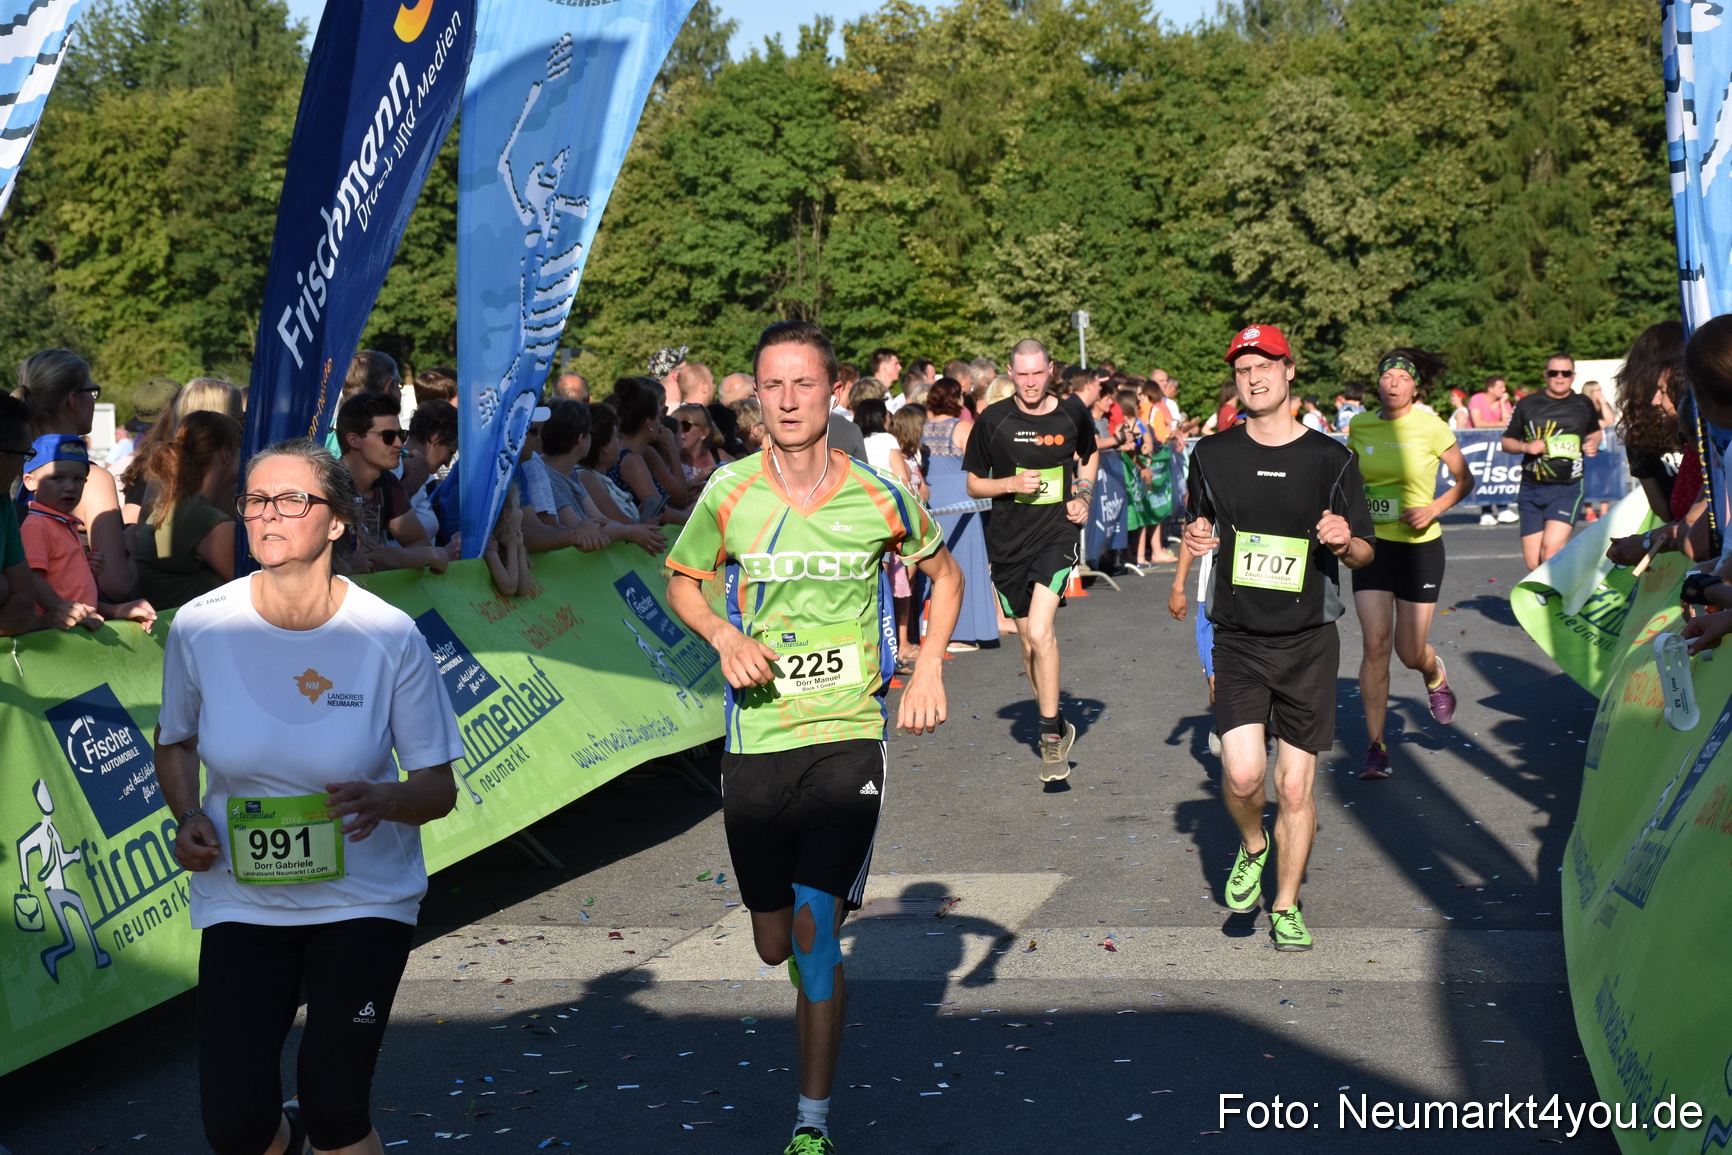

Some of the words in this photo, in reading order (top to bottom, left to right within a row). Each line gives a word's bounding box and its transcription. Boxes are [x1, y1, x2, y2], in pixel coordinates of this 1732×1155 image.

[357, 155, 394, 232] Druck
[393, 99, 416, 159] und
[416, 10, 462, 108] Medien
[277, 62, 410, 370] Frischmann
[741, 552, 872, 582] BOCK
[1243, 552, 1297, 576] 1707
[205, 595, 228, 607] JAKO
[432, 641, 457, 664] scher
[787, 648, 844, 680] 225
[304, 681, 320, 690] NM
[796, 679, 812, 688] Dörr
[814, 674, 841, 685] Manuel
[327, 692, 364, 701] LANDKREIS
[327, 699, 364, 708] NEUMARKT
[461, 655, 565, 778] irmenlauf
[82, 725, 133, 765] Fischer
[100, 745, 140, 776] AUTOMOBILE
[480, 743, 531, 793] neumarkt
[239, 811, 276, 820] firmenlauf
[249, 827, 311, 860] 991
[275, 860, 314, 870] Gabriele
[276, 869, 306, 877] Neumarkt
